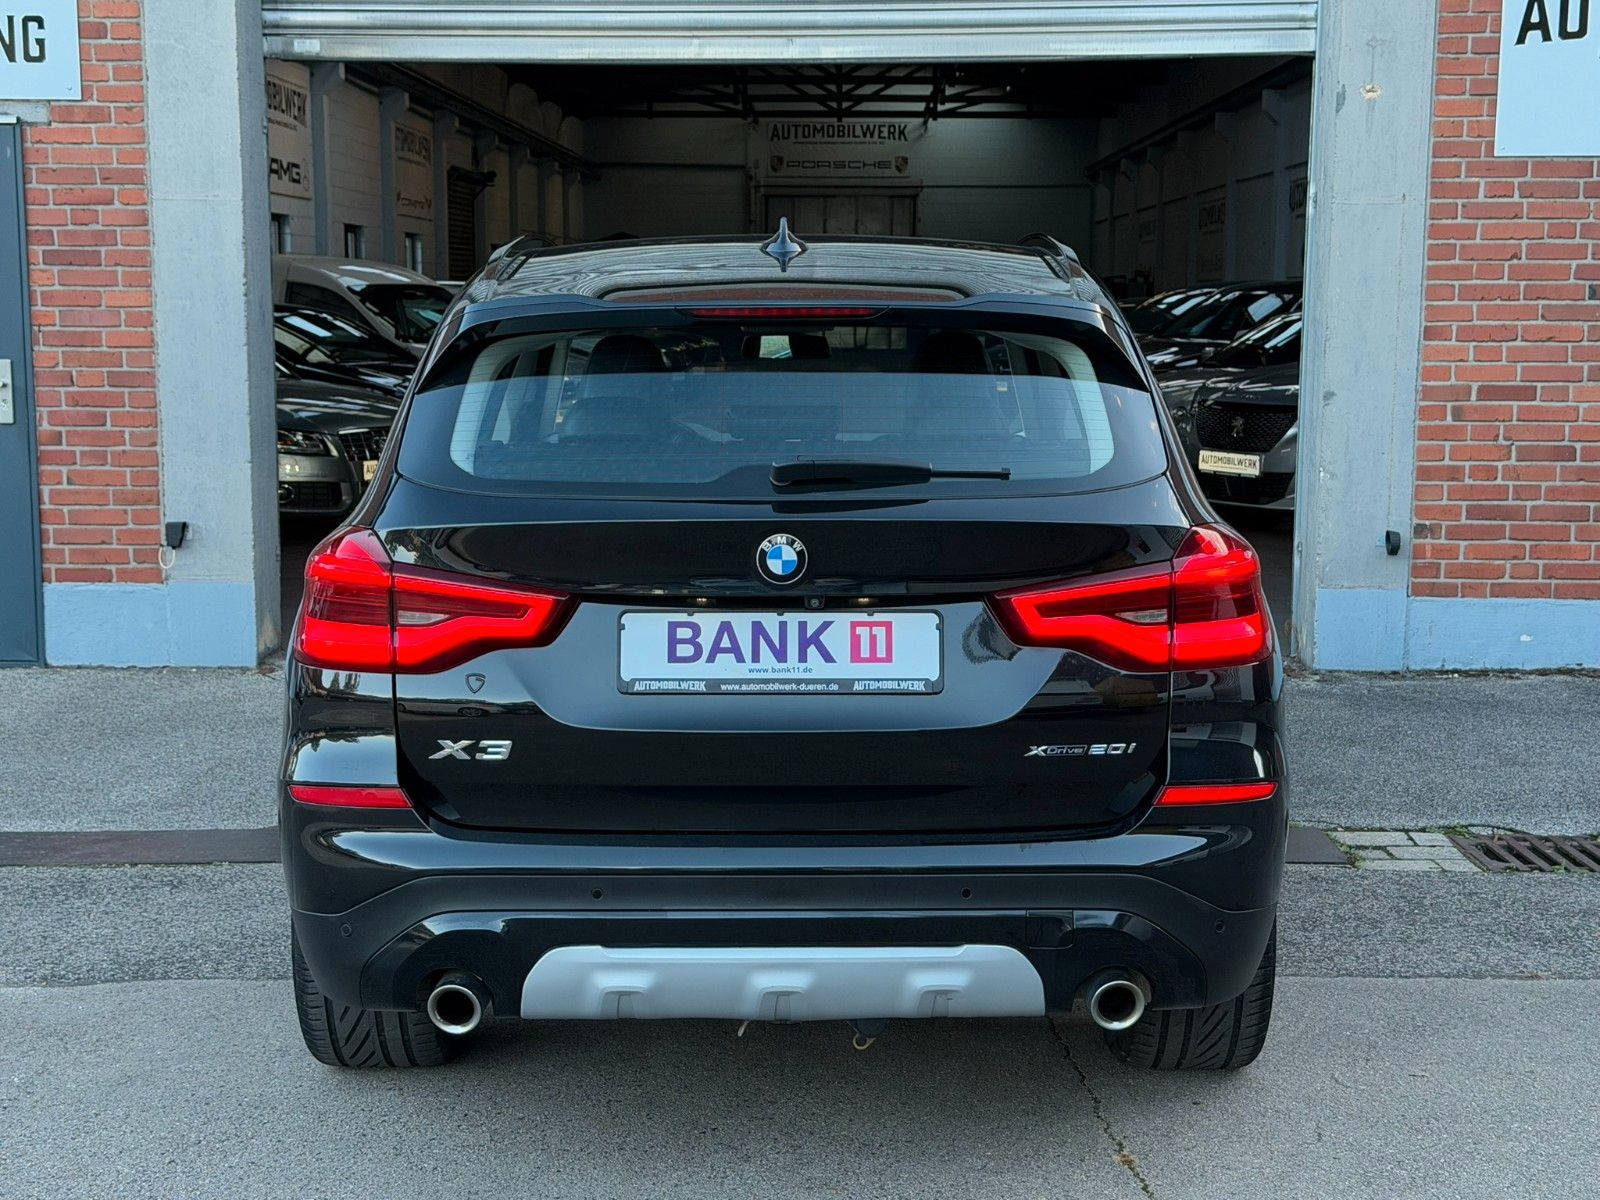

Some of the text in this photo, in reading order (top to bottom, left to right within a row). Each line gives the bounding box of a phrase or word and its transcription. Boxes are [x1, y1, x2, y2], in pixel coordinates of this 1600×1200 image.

[769, 123, 909, 142] AUTOMOBILWERK
[270, 157, 301, 184] AMG
[786, 160, 893, 169] PORSCHE
[1201, 454, 1257, 469] AUTOMOBILWERK
[763, 535, 803, 552] BMW
[667, 620, 888, 664] BANK 11
[748, 666, 813, 675] www.bank11.de
[633, 680, 707, 692] AUTOMOBILWERK
[720, 682, 839, 693] www.automobilwerk-dueren.de
[853, 680, 926, 692] AUTOMOBILWERK
[427, 739, 513, 760] X3
